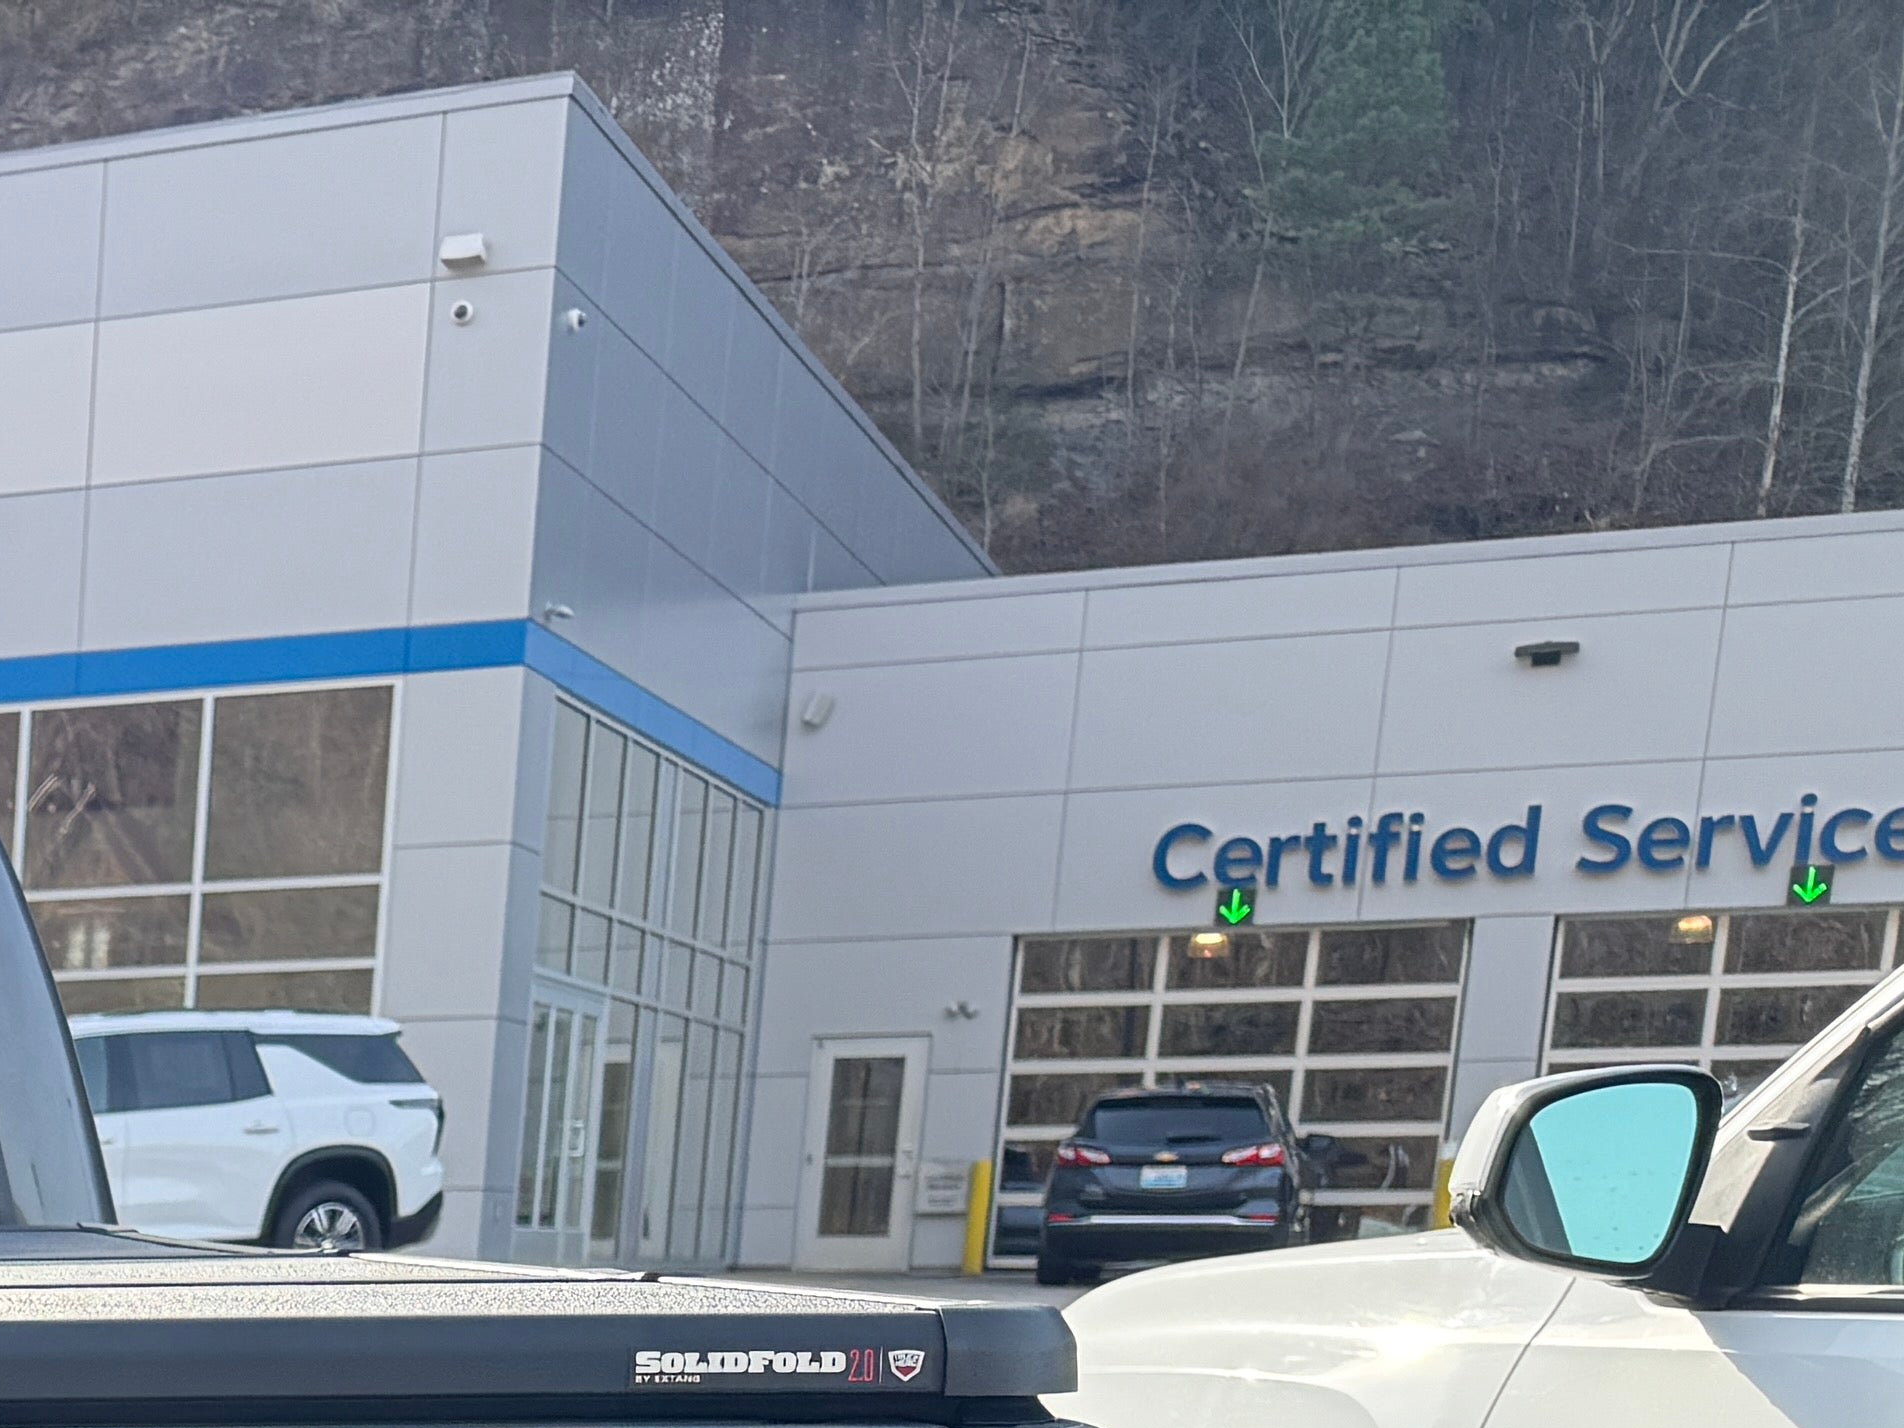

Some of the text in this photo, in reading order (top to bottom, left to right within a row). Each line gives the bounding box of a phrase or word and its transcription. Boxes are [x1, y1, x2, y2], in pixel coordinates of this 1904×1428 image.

[1152, 792, 1904, 890] Certified Service
[635, 1375, 701, 1384] BY EXTANG
[847, 1348, 874, 1383] 2.0
